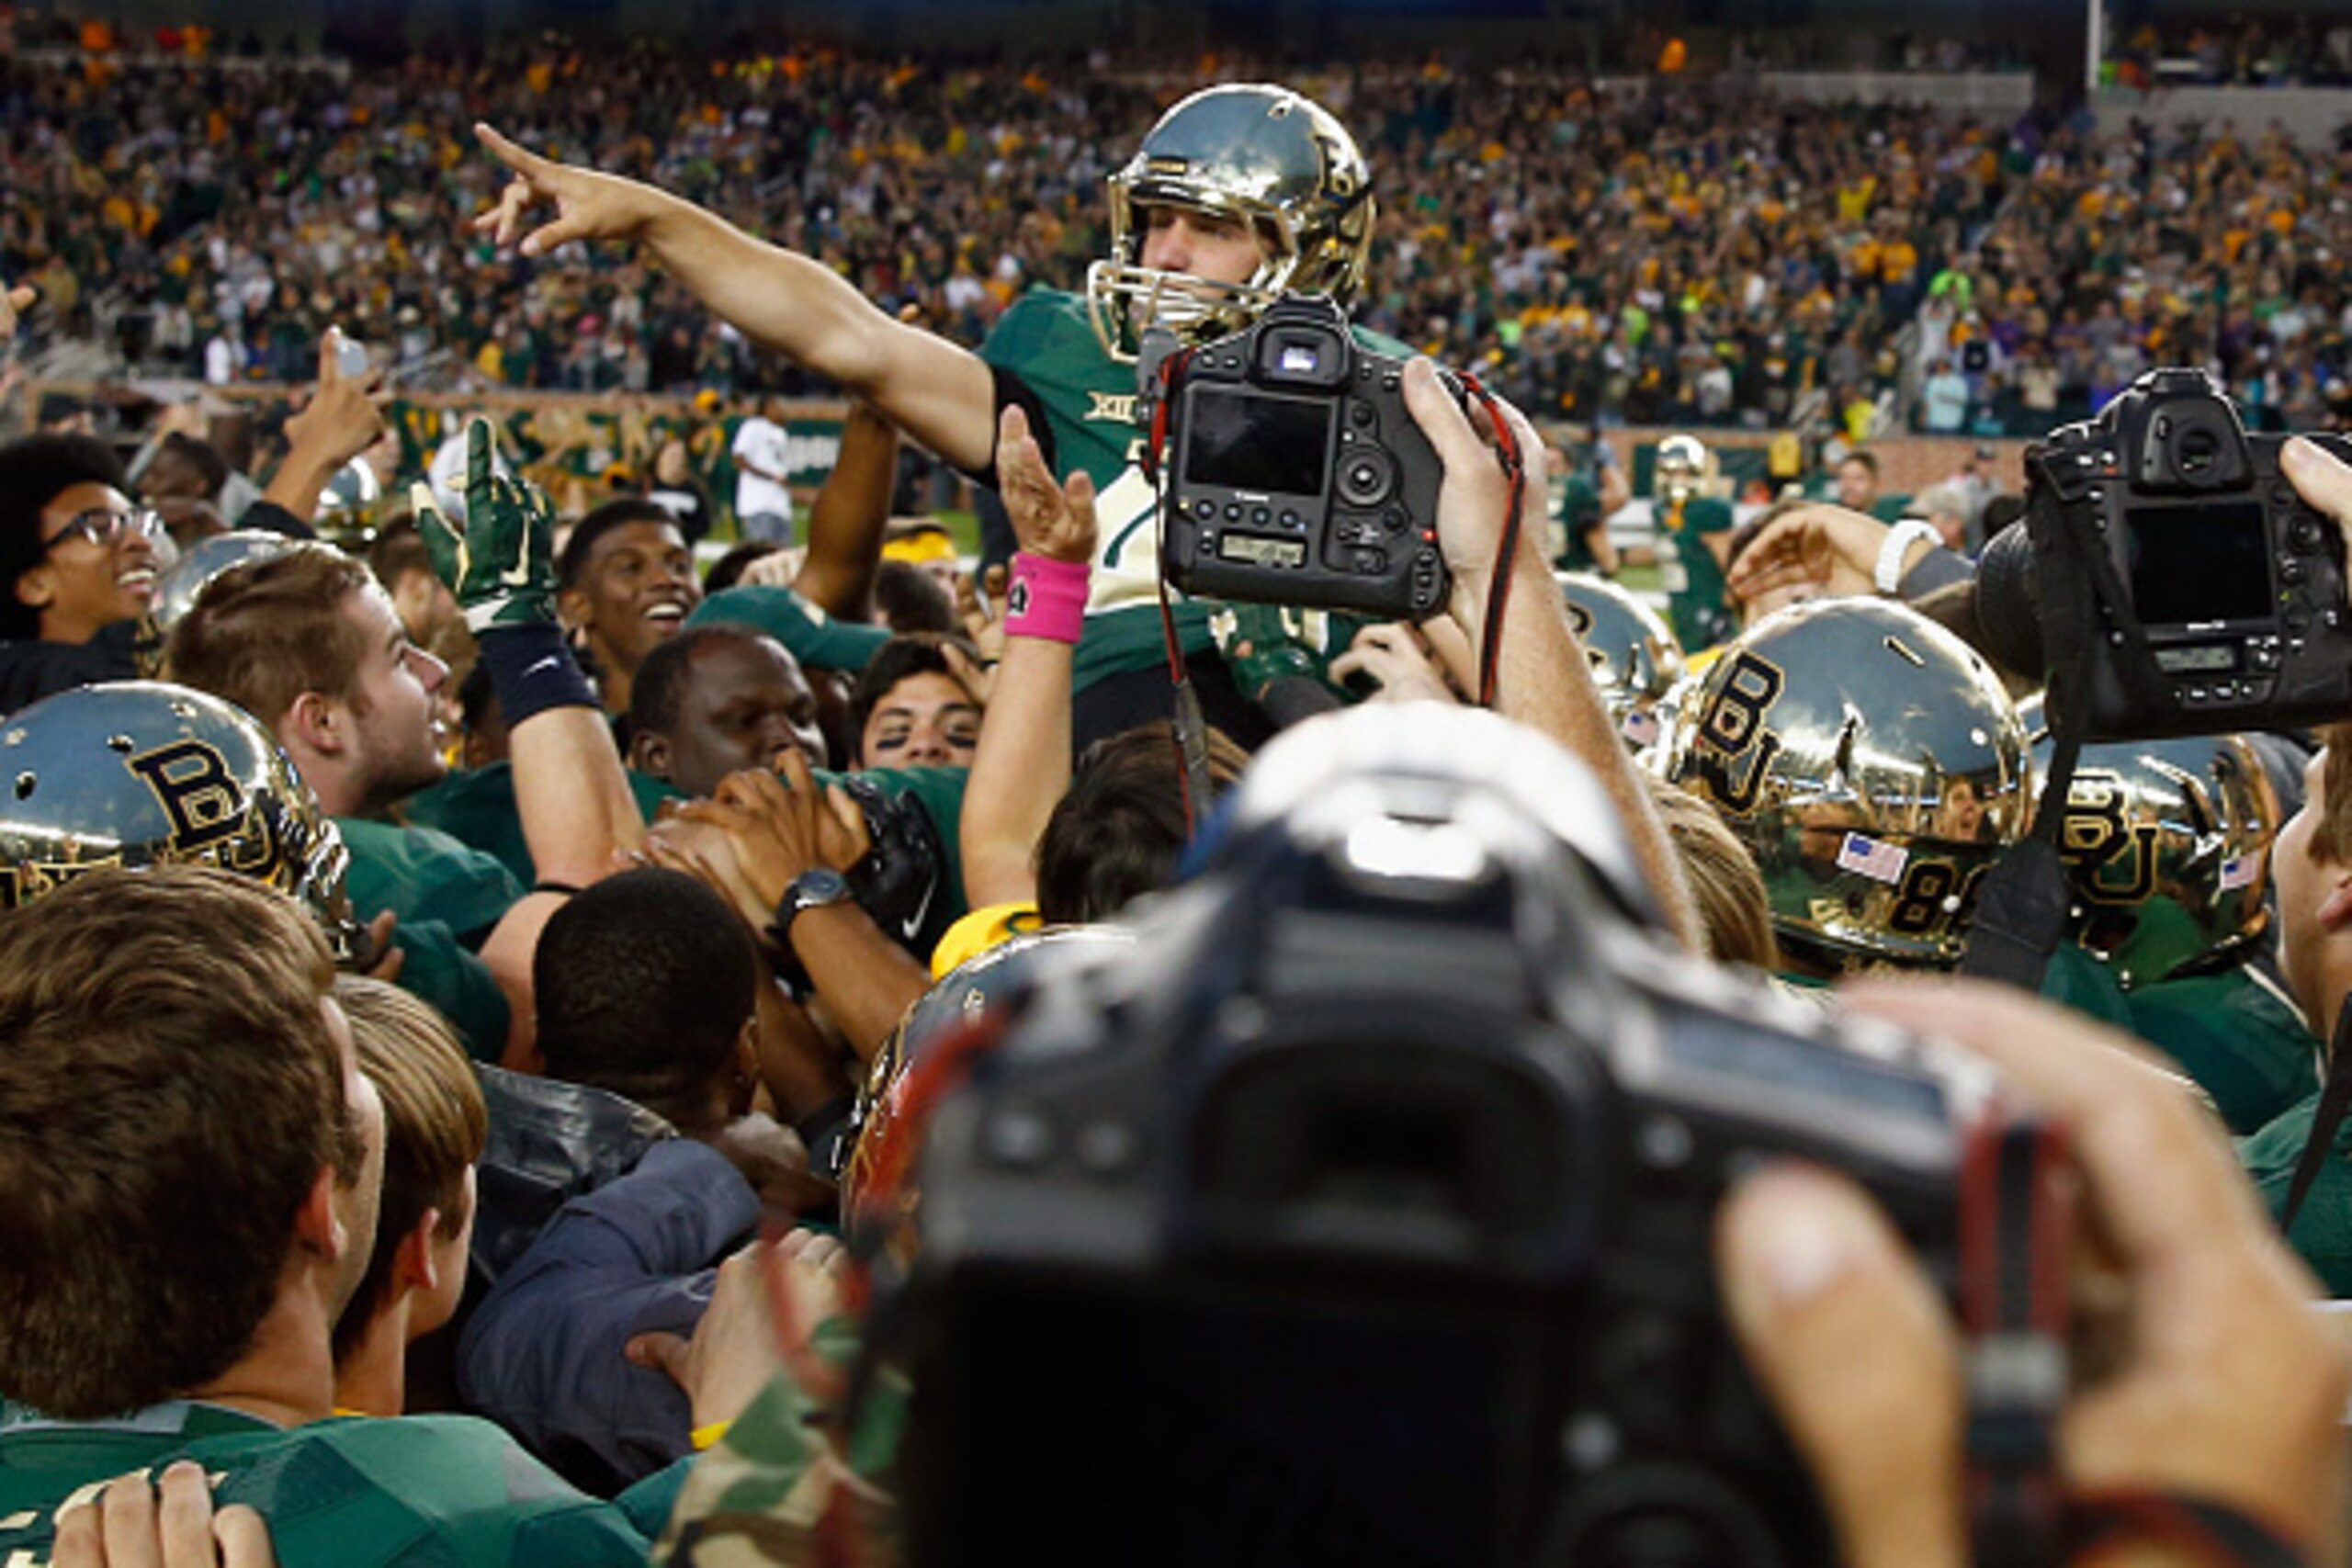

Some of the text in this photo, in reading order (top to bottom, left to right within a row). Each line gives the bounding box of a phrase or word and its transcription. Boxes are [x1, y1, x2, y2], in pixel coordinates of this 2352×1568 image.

[1697, 648, 1785, 817] BU
[123, 737, 287, 879] BU
[2053, 765, 2162, 905] BU
